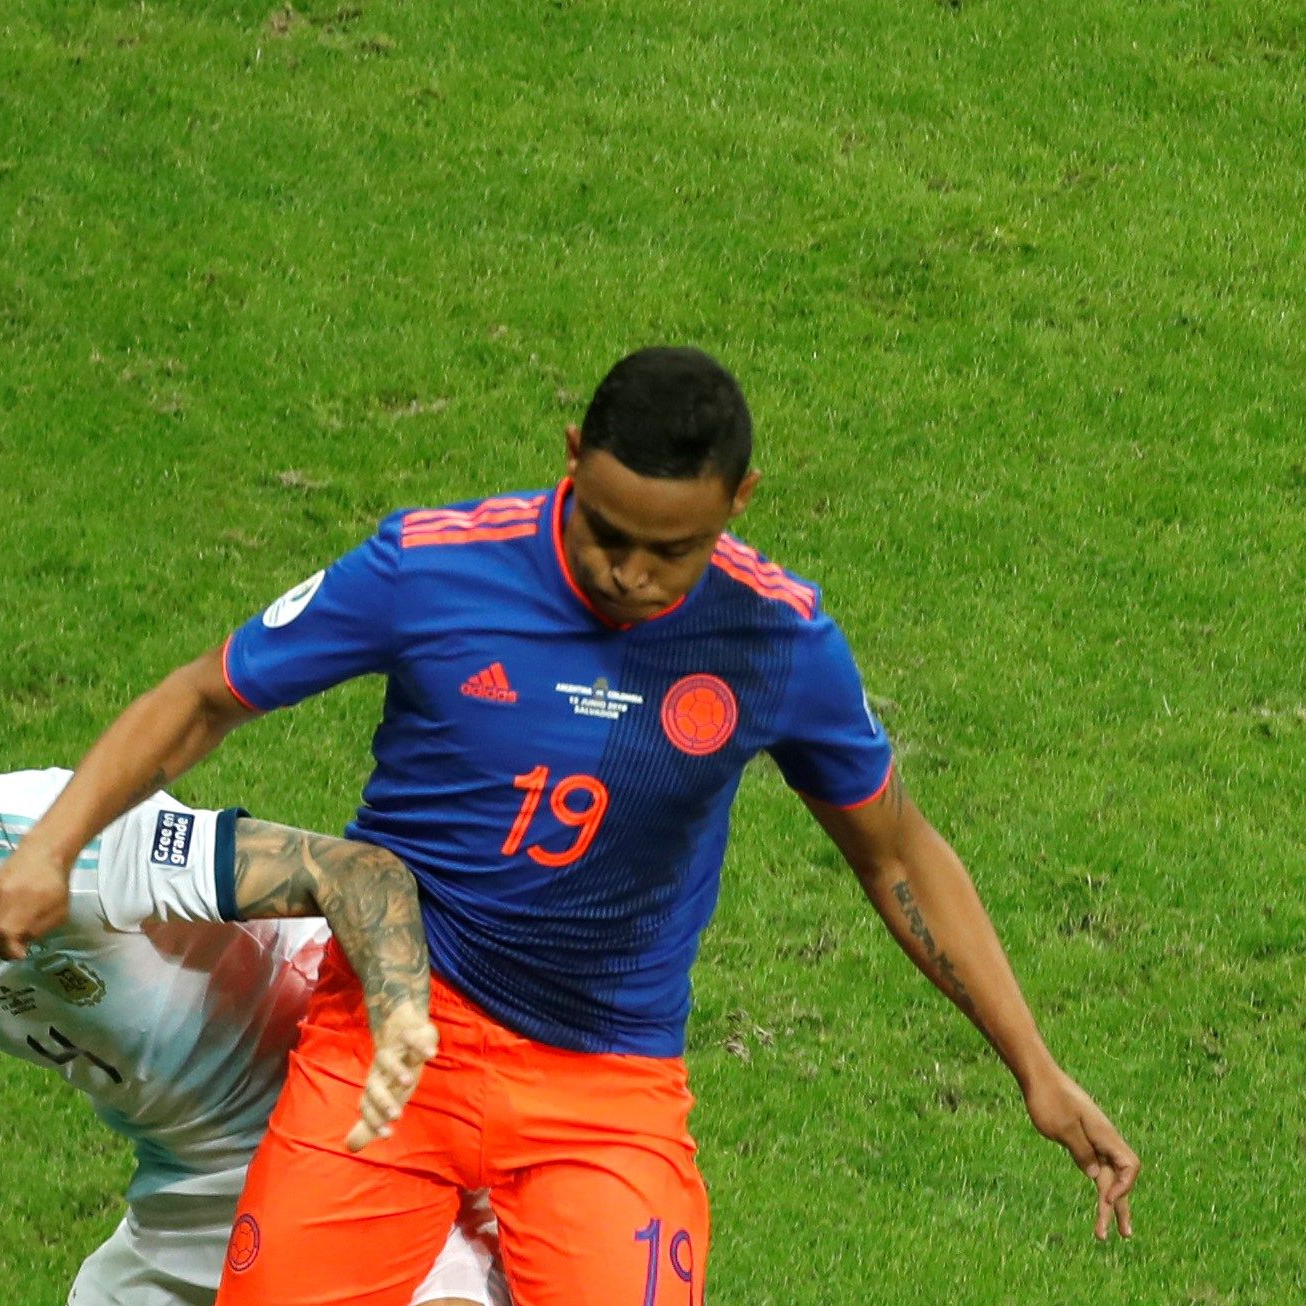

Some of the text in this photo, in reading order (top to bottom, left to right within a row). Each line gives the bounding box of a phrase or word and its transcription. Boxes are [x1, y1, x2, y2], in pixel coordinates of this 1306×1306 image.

[461, 682, 517, 703] adidas
[154, 813, 175, 861] Cree en
[501, 764, 609, 867] 19
[171, 817, 189, 865] grande
